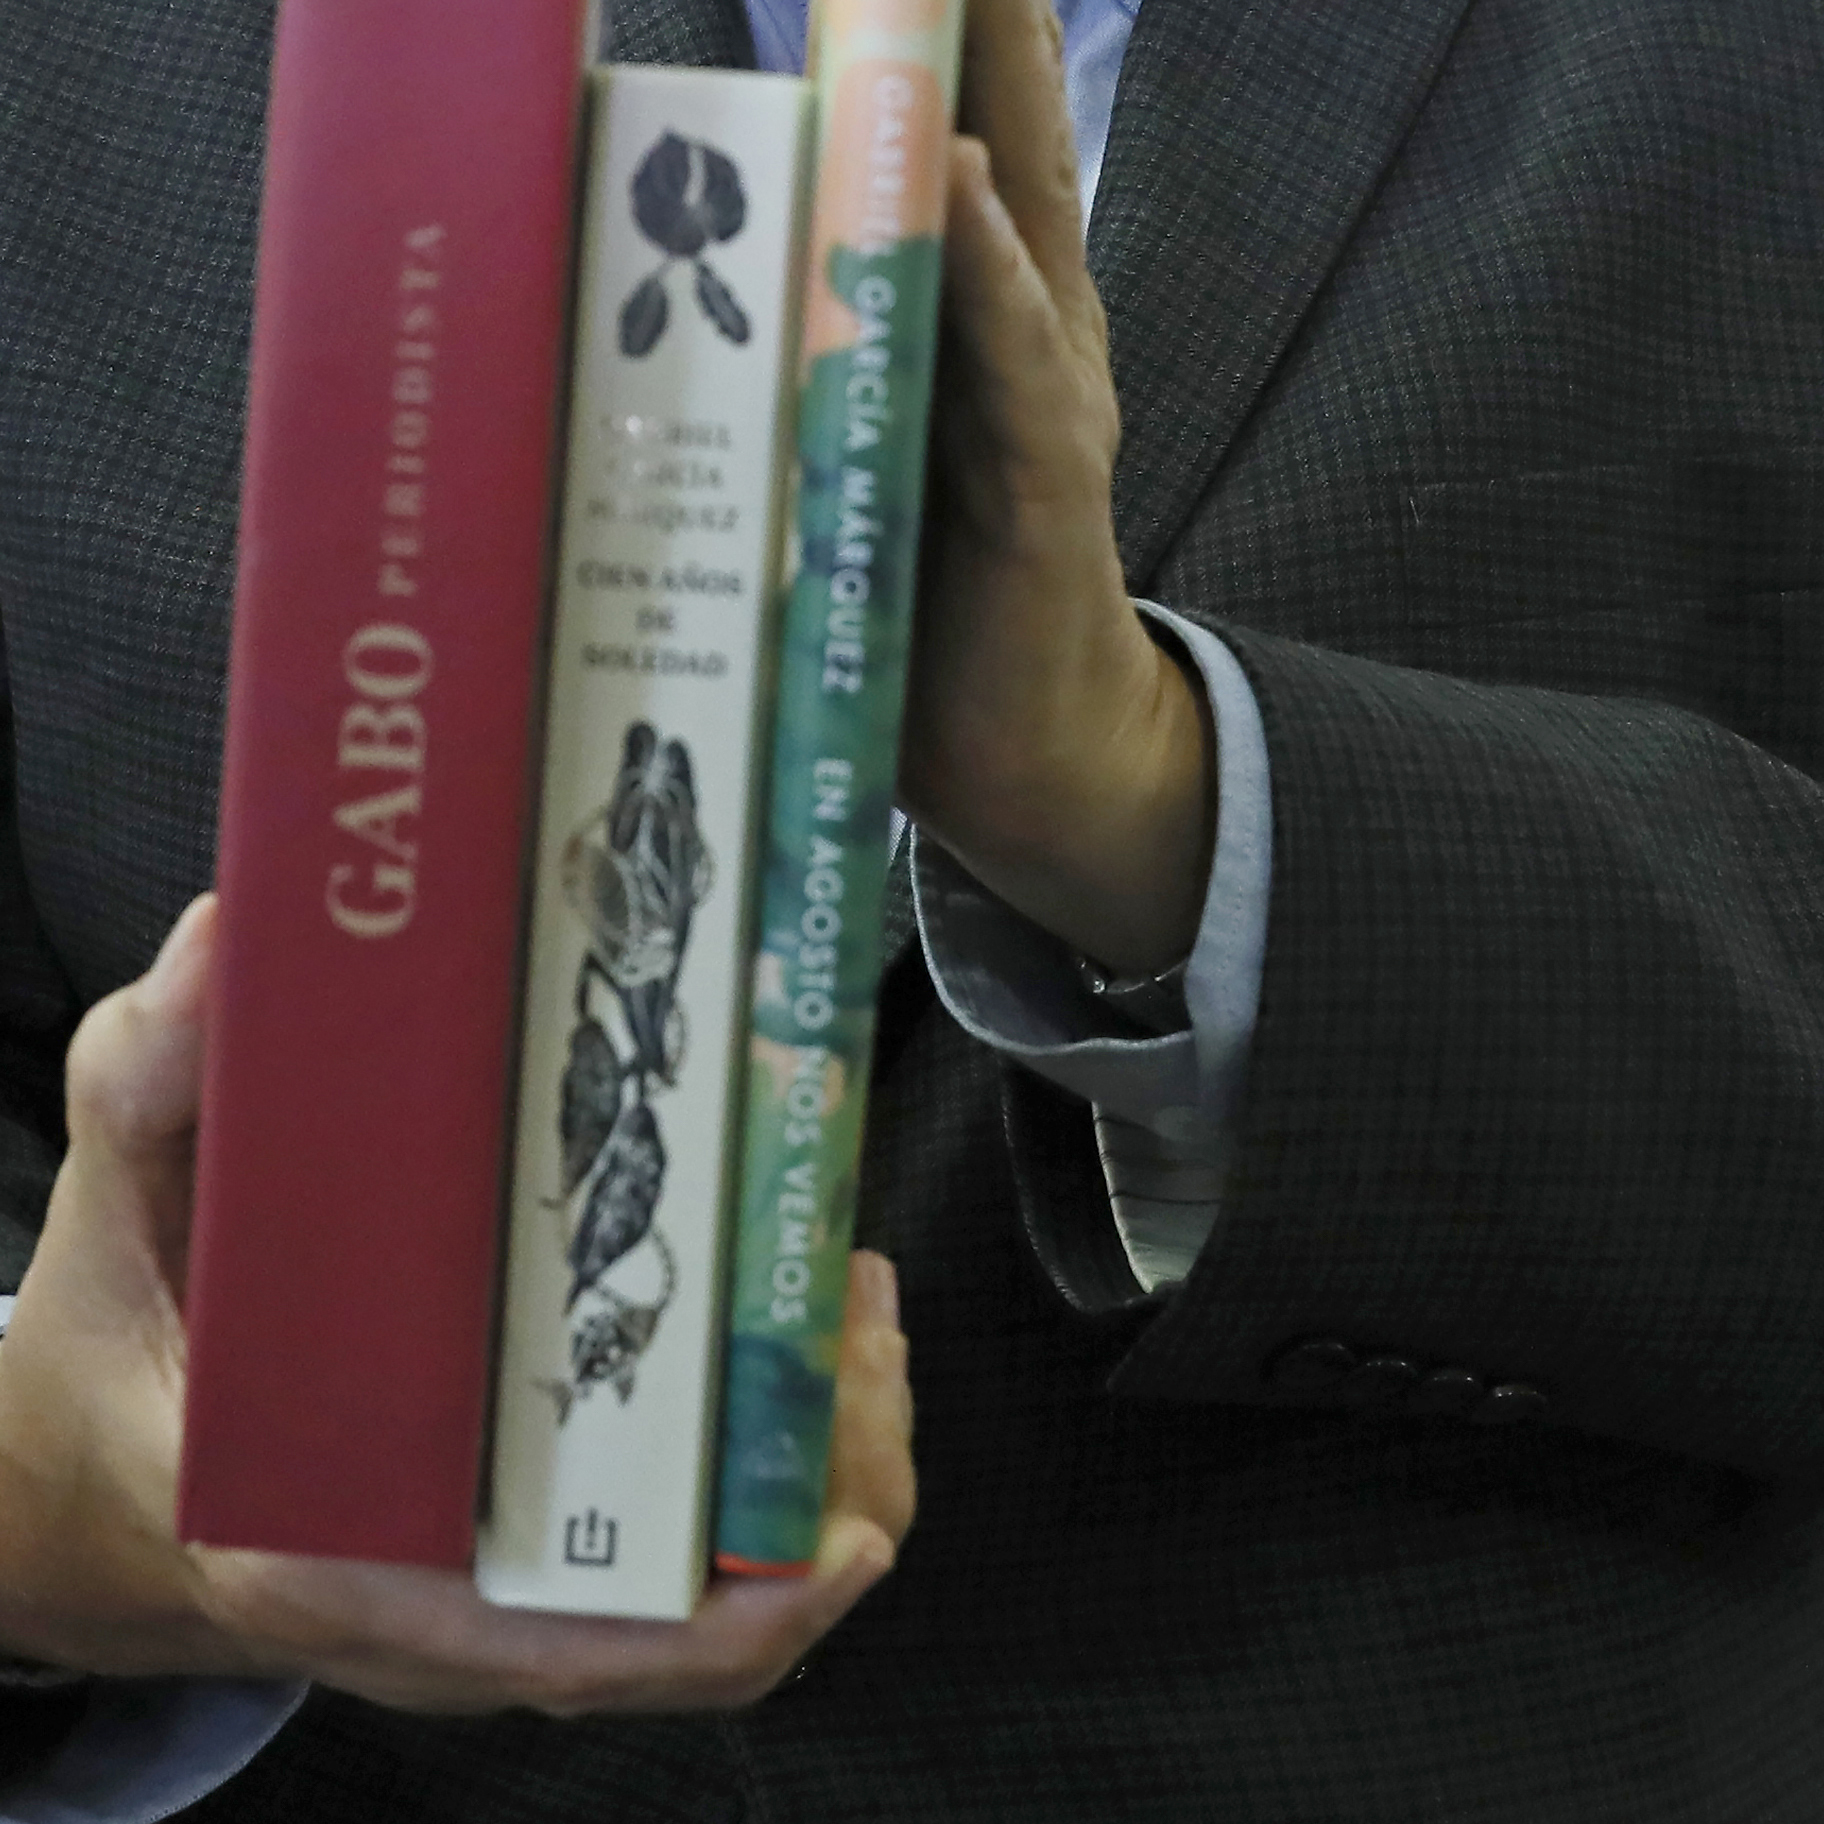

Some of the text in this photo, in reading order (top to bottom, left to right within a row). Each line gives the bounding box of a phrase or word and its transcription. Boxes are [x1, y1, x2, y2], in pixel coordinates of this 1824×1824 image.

[843, 275, 898, 452] GARCÍA
[326, 221, 448, 940] GABO PERIODISTA
[576, 559, 743, 598] CIEN AÑOS
[634, 606, 674, 632] DE
[822, 465, 884, 694] MÁRQUEZ
[579, 642, 730, 679] SOLEDAD
[812, 757, 854, 822] EN
[793, 833, 844, 1032] AGOSTO
[783, 1044, 828, 1146] NOS
[770, 1162, 816, 1324] VEMOS
